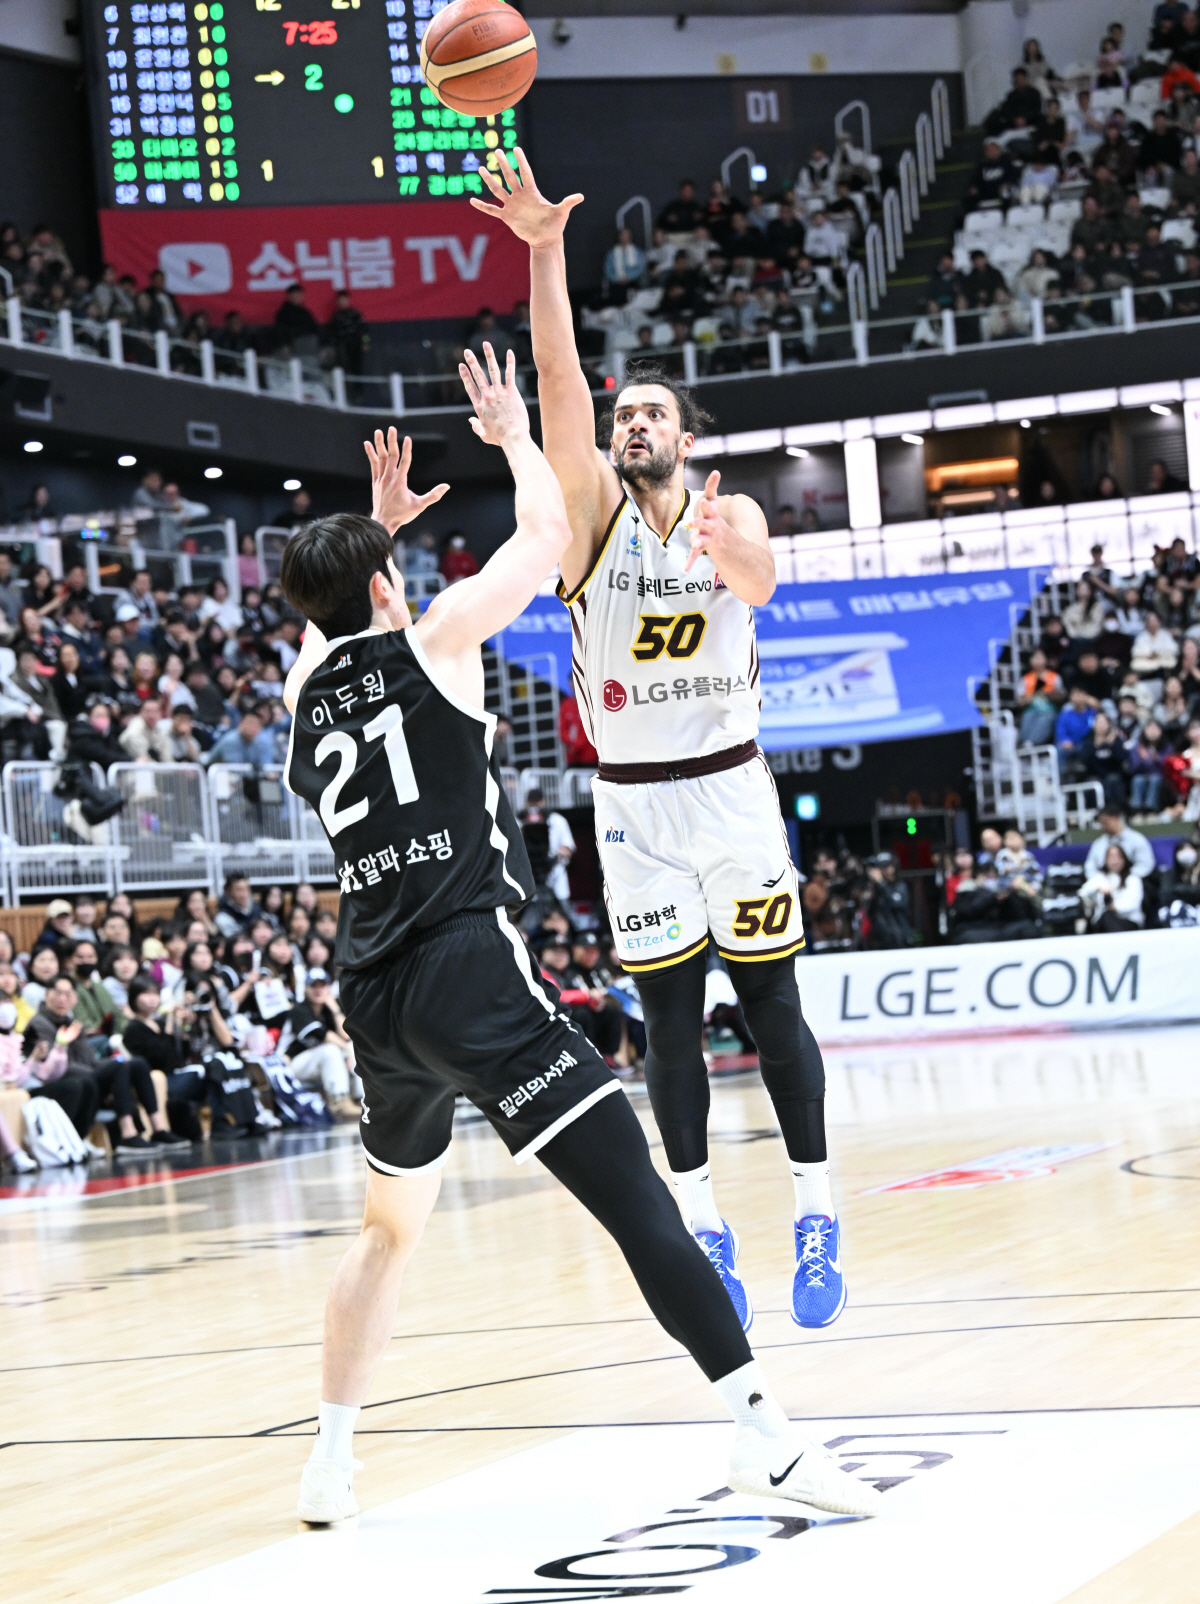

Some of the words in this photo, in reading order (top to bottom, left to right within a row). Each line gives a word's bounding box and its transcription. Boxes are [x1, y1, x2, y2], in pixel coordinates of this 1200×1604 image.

[194, 3, 208, 21] 0
[210, 3, 223, 21] 0
[106, 27, 119, 45] 7
[198, 26, 208, 43] 1
[212, 25, 226, 43] 0
[282, 20, 338, 45] 7:25
[472, 20, 498, 36] FIBA
[198, 48, 212, 66] 0
[214, 47, 228, 66] 0
[108, 72, 128, 91] 11
[200, 70, 214, 88] 0
[216, 70, 229, 88] 0
[304, 64, 324, 90] 2
[390, 65, 411, 84] 1
[202, 93, 216, 111] 0
[109, 117, 131, 136] 31
[204, 115, 218, 133] 0
[219, 115, 234, 133] 0
[501, 108, 516, 126] 2
[205, 138, 220, 156] 0
[221, 137, 236, 155] 2
[484, 129, 499, 148] 0
[503, 129, 517, 148] 2
[210, 160, 220, 179] 1
[223, 160, 238, 179] 3
[261, 160, 274, 182] 1
[371, 156, 384, 178] 1
[395, 154, 417, 173] 31
[209, 183, 224, 202] 0
[225, 182, 240, 202] 0
[397, 175, 420, 195] 77
[247, 236, 395, 292] 소닉붐
[404, 234, 489, 284] TV
[607, 568, 630, 592] LG
[685, 579, 712, 595] evo
[630, 610, 708, 663] 50
[312, 669, 385, 726] 이두원
[632, 675, 747, 706] LG유플러스
[314, 703, 420, 838] 21
[405, 828, 453, 865] 쇼핑
[616, 904, 678, 933] LG화학
[730, 890, 793, 939] 50
[840, 954, 1140, 1021] LGE.COM
[498, 1049, 578, 1119] 밀리의서재
